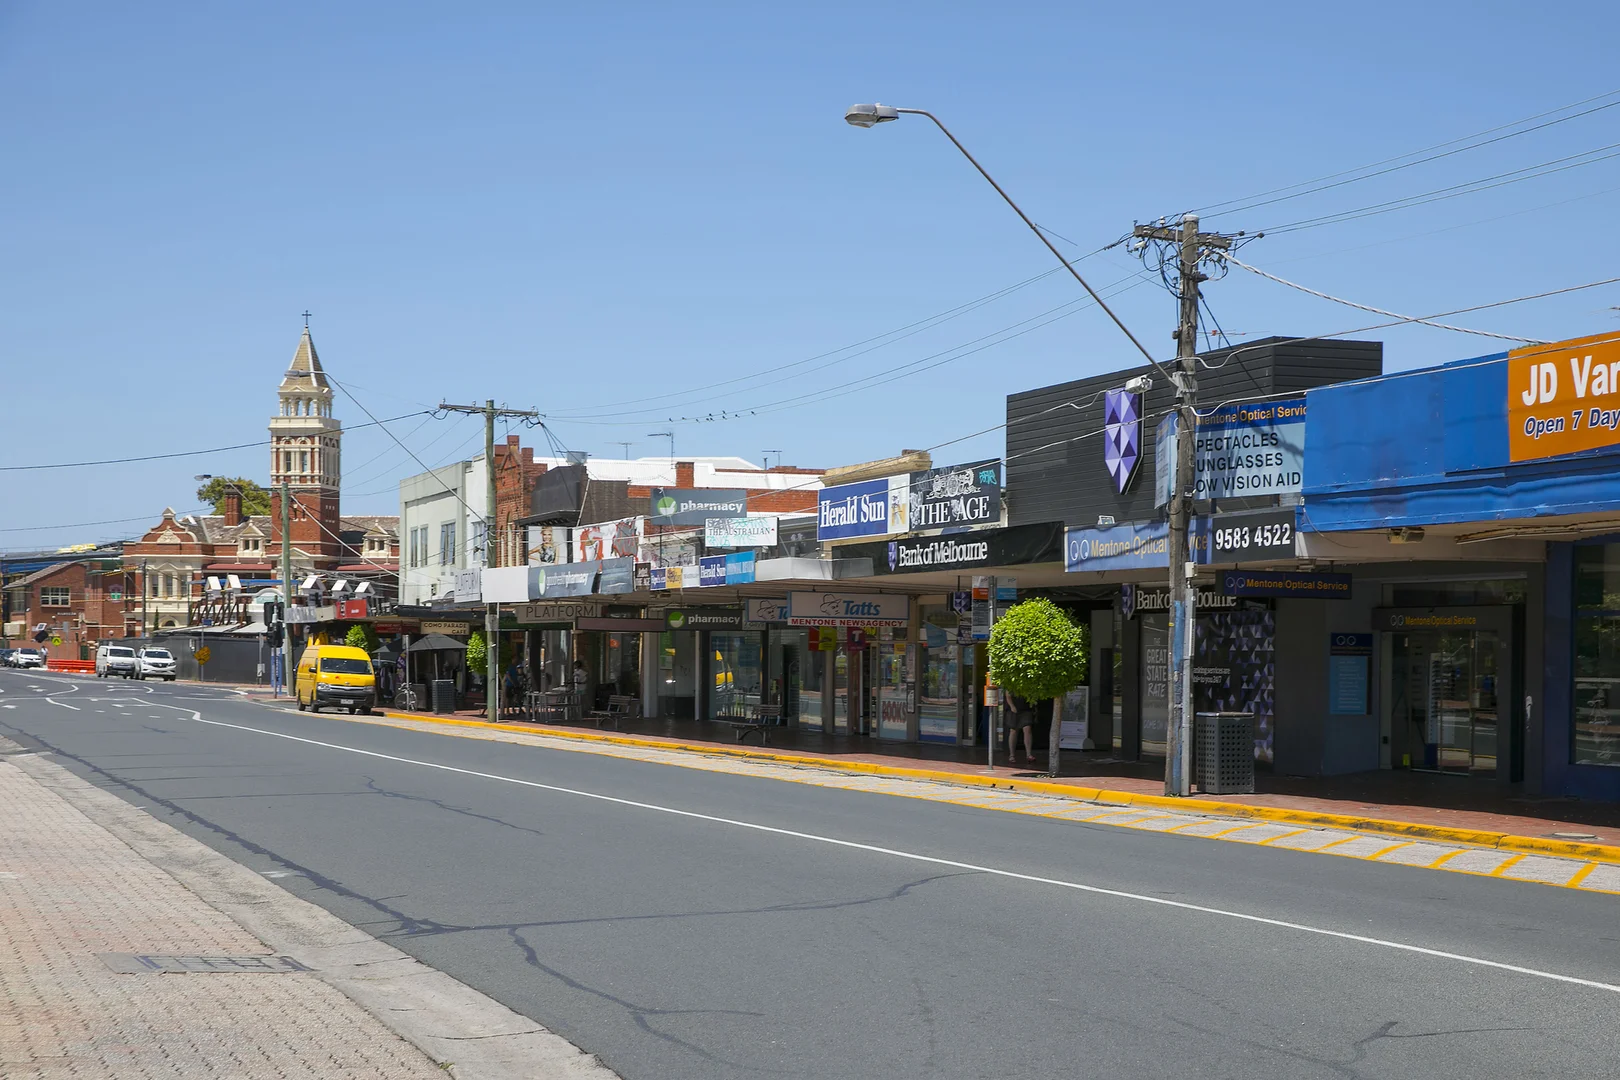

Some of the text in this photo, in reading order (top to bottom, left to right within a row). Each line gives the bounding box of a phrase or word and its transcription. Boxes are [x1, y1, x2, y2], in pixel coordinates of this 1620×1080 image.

[1522, 355, 1620, 406] JD Var
[1196, 413, 1237, 426] Mentone
[1239, 407, 1275, 423] Optical
[1524, 407, 1620, 440] Open 7 Day
[1196, 432, 1279, 453] PECTACLES
[1196, 452, 1284, 473] UNGLASSES
[1195, 471, 1301, 493] OW VISION AID
[680, 499, 744, 514] pharmacy
[820, 493, 886, 528] Herald Sun
[918, 495, 990, 527] THE AGE
[708, 527, 771, 537] THE AUSTRALIAN
[1215, 523, 1291, 550] 9583 4522
[898, 541, 988, 568] Bank of Melbourne
[1090, 538, 1131, 558] Mentone
[1132, 535, 1167, 559] Optical
[700, 564, 716, 578] Herald
[716, 563, 726, 577] Sun
[1246, 578, 1349, 592] Mentone Optical Service
[842, 600, 881, 616] Tatts
[1136, 588, 1237, 610] Bank o bourne
[525, 605, 594, 619] PLATFORM
[688, 614, 741, 625] pharmacy
[1405, 615, 1477, 628] Mentone Optical Service
[791, 618, 904, 627] MENTONE NEWSAGENCY
[1146, 648, 1168, 664] GREAT
[1146, 665, 1168, 682] STATE
[1147, 682, 1167, 698] RATE
[882, 700, 907, 723] BOOKS
